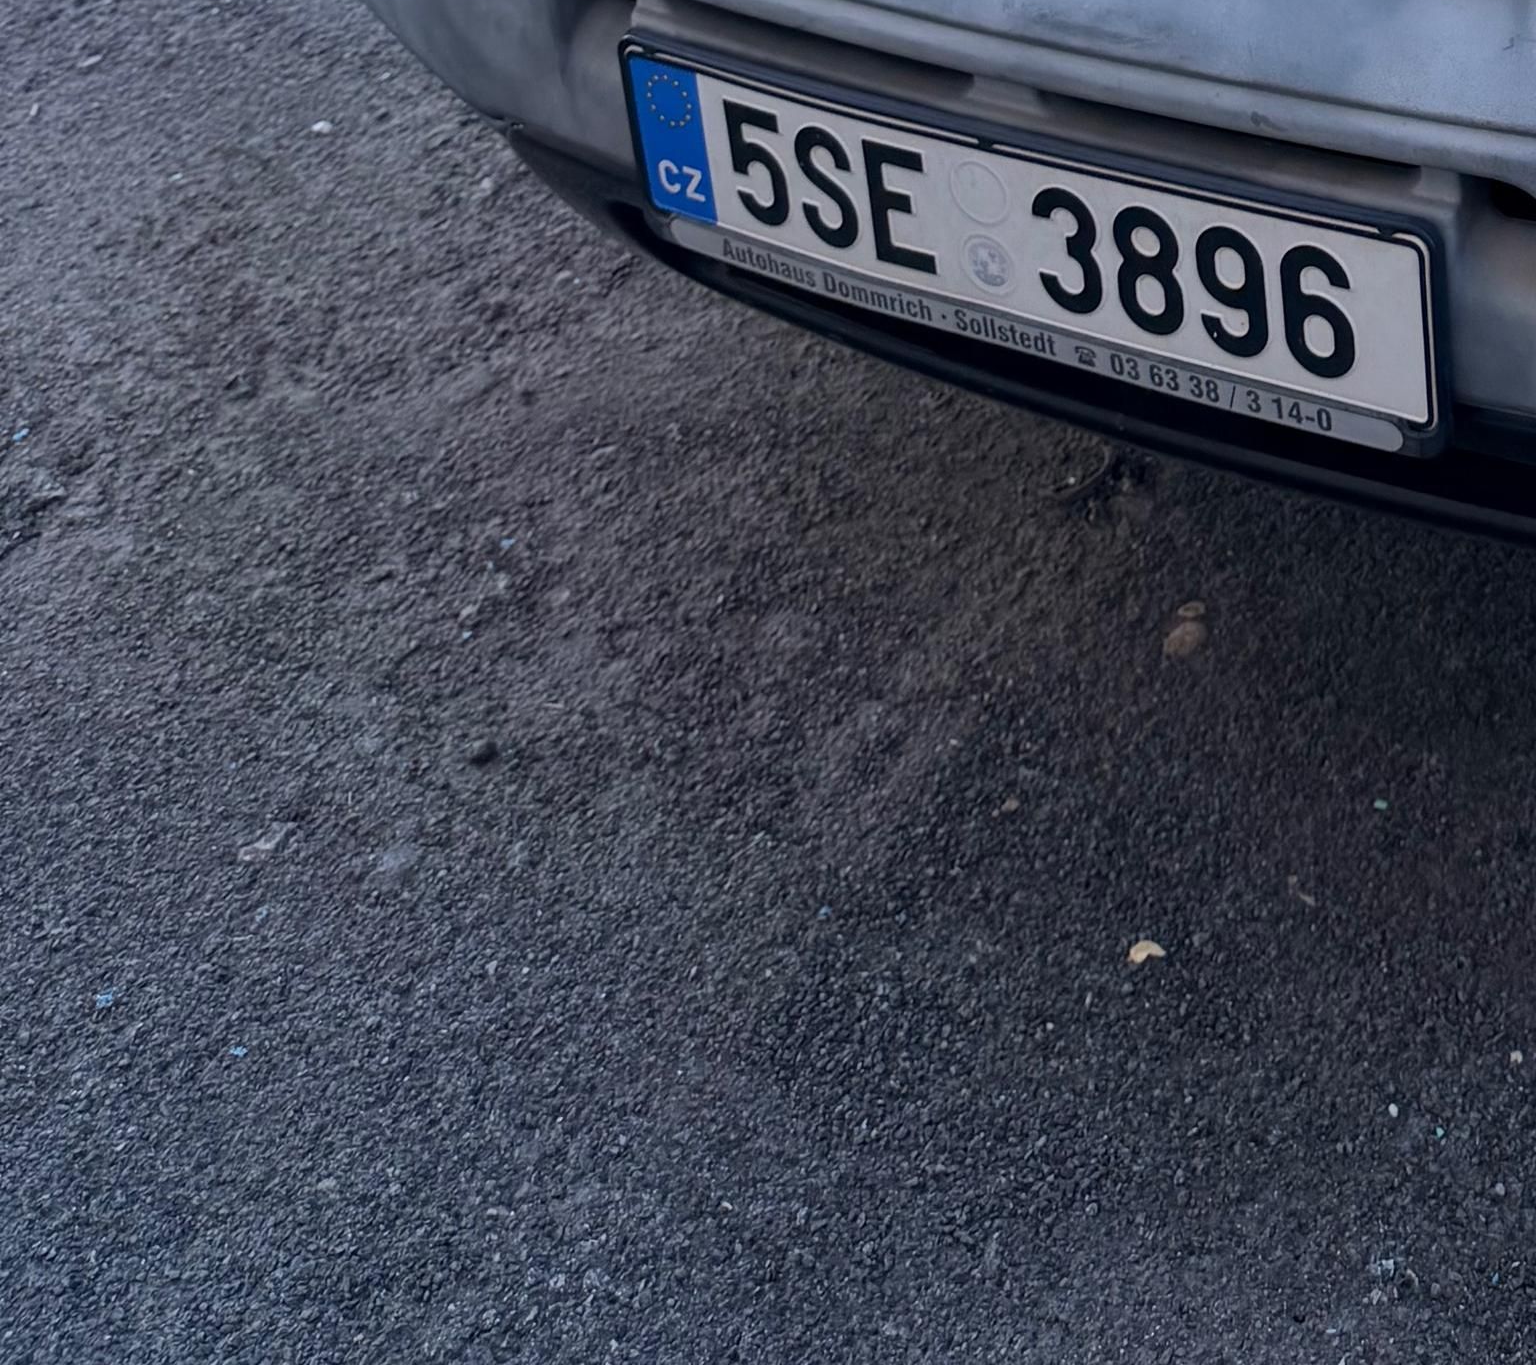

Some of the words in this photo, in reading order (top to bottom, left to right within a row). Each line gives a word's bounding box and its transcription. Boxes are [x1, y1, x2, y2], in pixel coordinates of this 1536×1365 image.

[658, 158, 706, 203] CZ
[722, 98, 938, 275] 5SE
[1031, 186, 1356, 379] 3896
[722, 237, 817, 288] Autohaus
[824, 272, 933, 323] Dommrich
[953, 308, 1056, 358] Sollstedt
[1110, 352, 1140, 380] 03
[1151, 364, 1179, 391] 63
[1190, 374, 1220, 403] 38
[1271, 397, 1332, 432] 14-0
